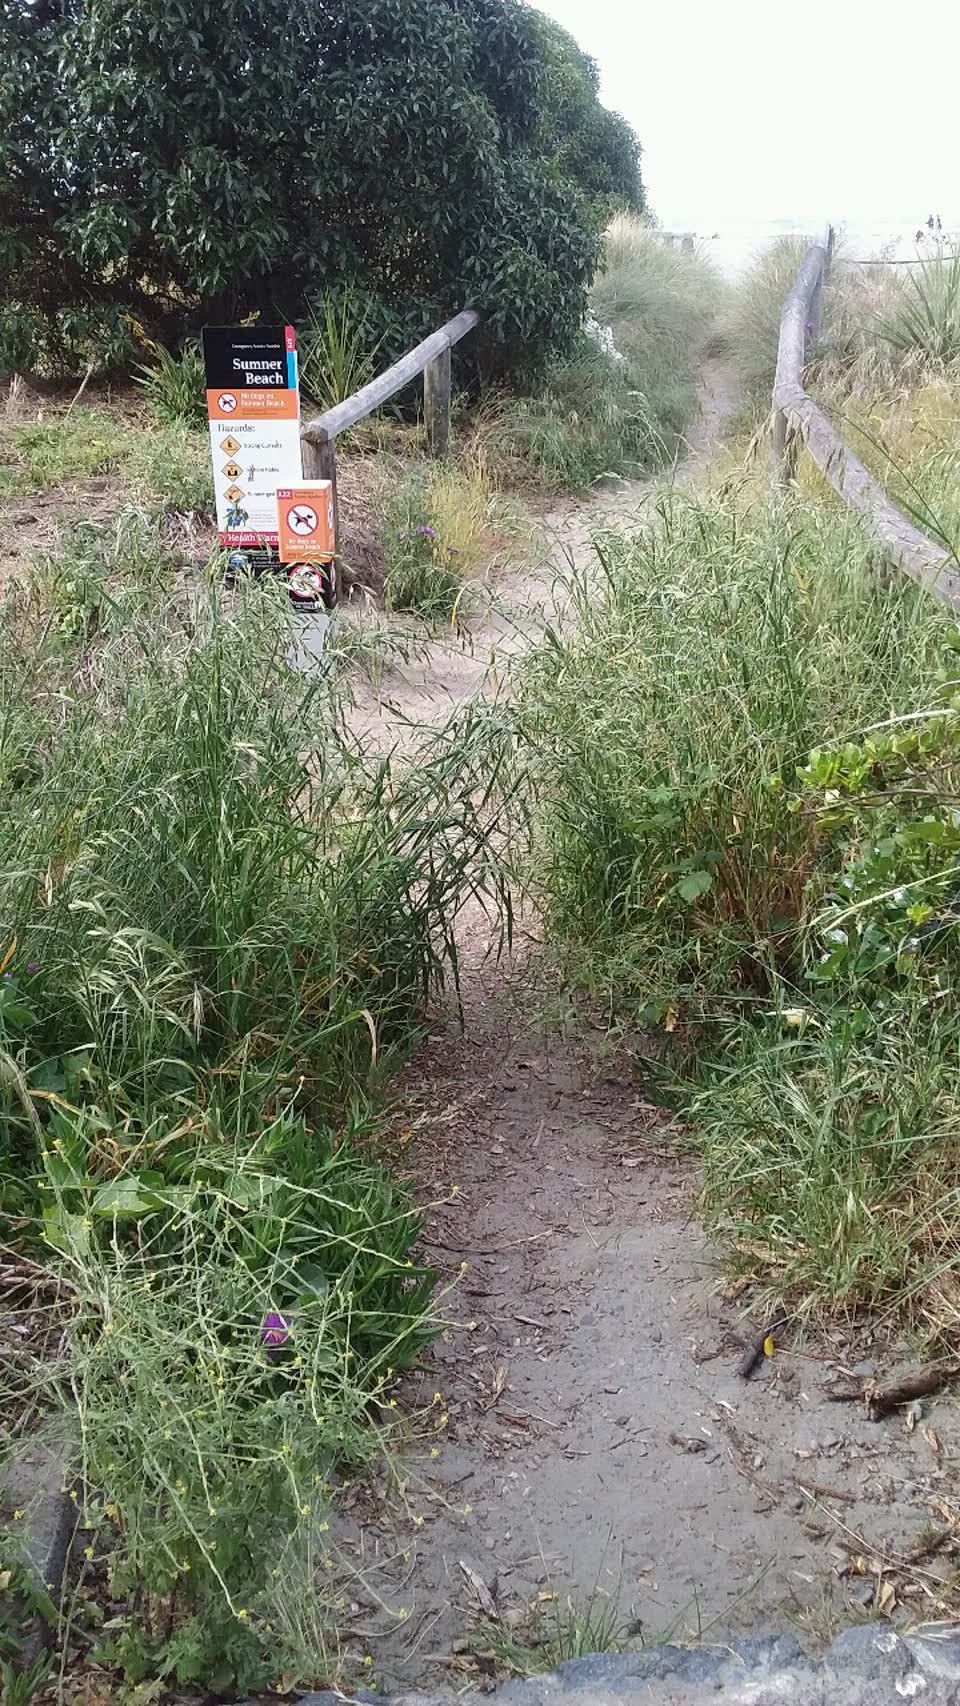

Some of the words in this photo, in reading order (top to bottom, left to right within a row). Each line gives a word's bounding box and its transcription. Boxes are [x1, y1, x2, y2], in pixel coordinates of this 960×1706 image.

[232, 358, 282, 370] Sumner
[245, 372, 284, 384] Beach
[218, 424, 255, 432] Hazards:
